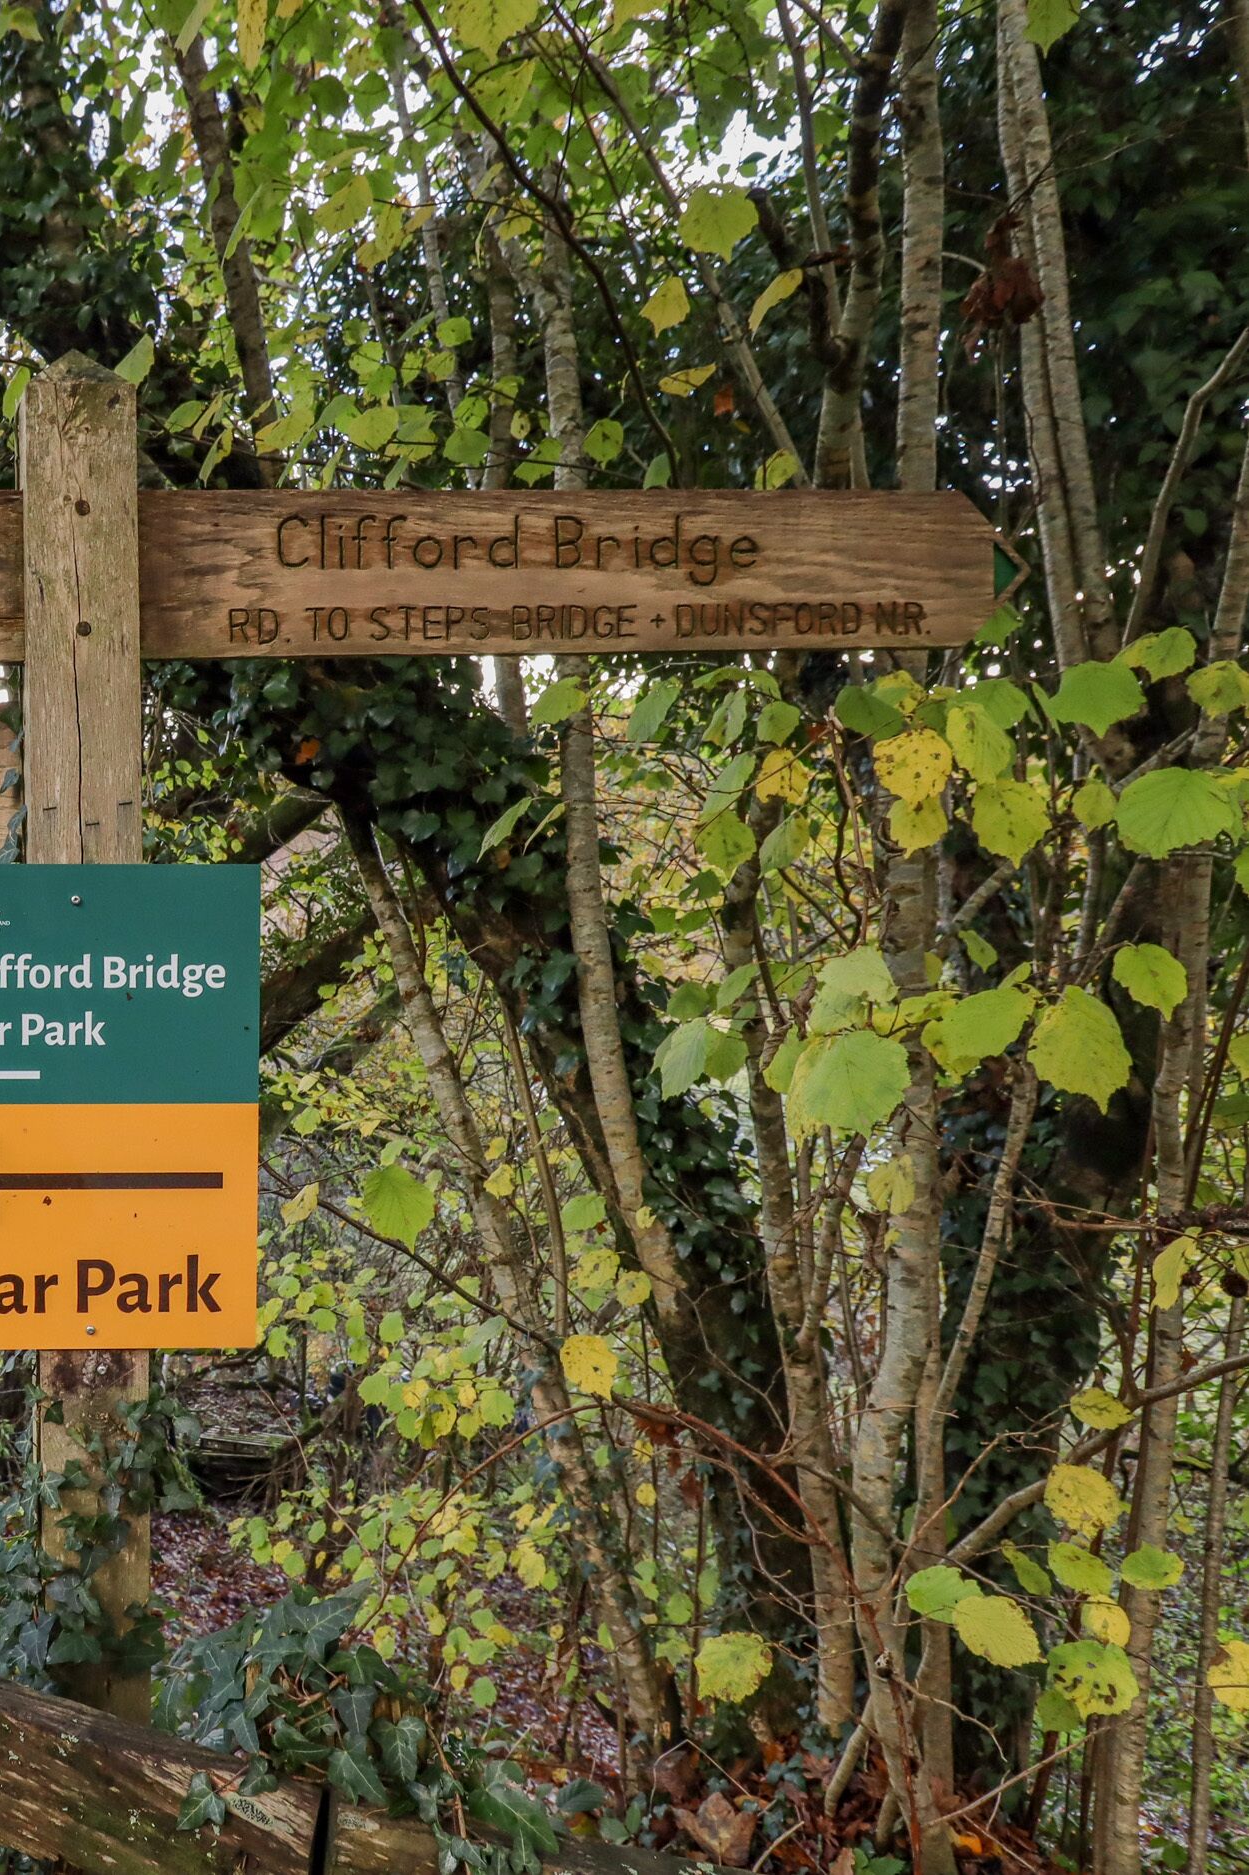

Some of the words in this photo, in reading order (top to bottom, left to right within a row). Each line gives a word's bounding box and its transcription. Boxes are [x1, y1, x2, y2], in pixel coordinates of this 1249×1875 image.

[276, 514, 520, 570] Clifford
[554, 514, 760, 586] Bridge
[229, 608, 292, 645] RD.
[305, 606, 350, 642] TO
[369, 605, 491, 643] STEPS
[511, 604, 638, 641] BRIDGE
[675, 602, 861, 639] DUNSFORD
[103, 953, 227, 998] Bridge
[21, 1010, 107, 1046] Park
[76, 1254, 223, 1314] Park
